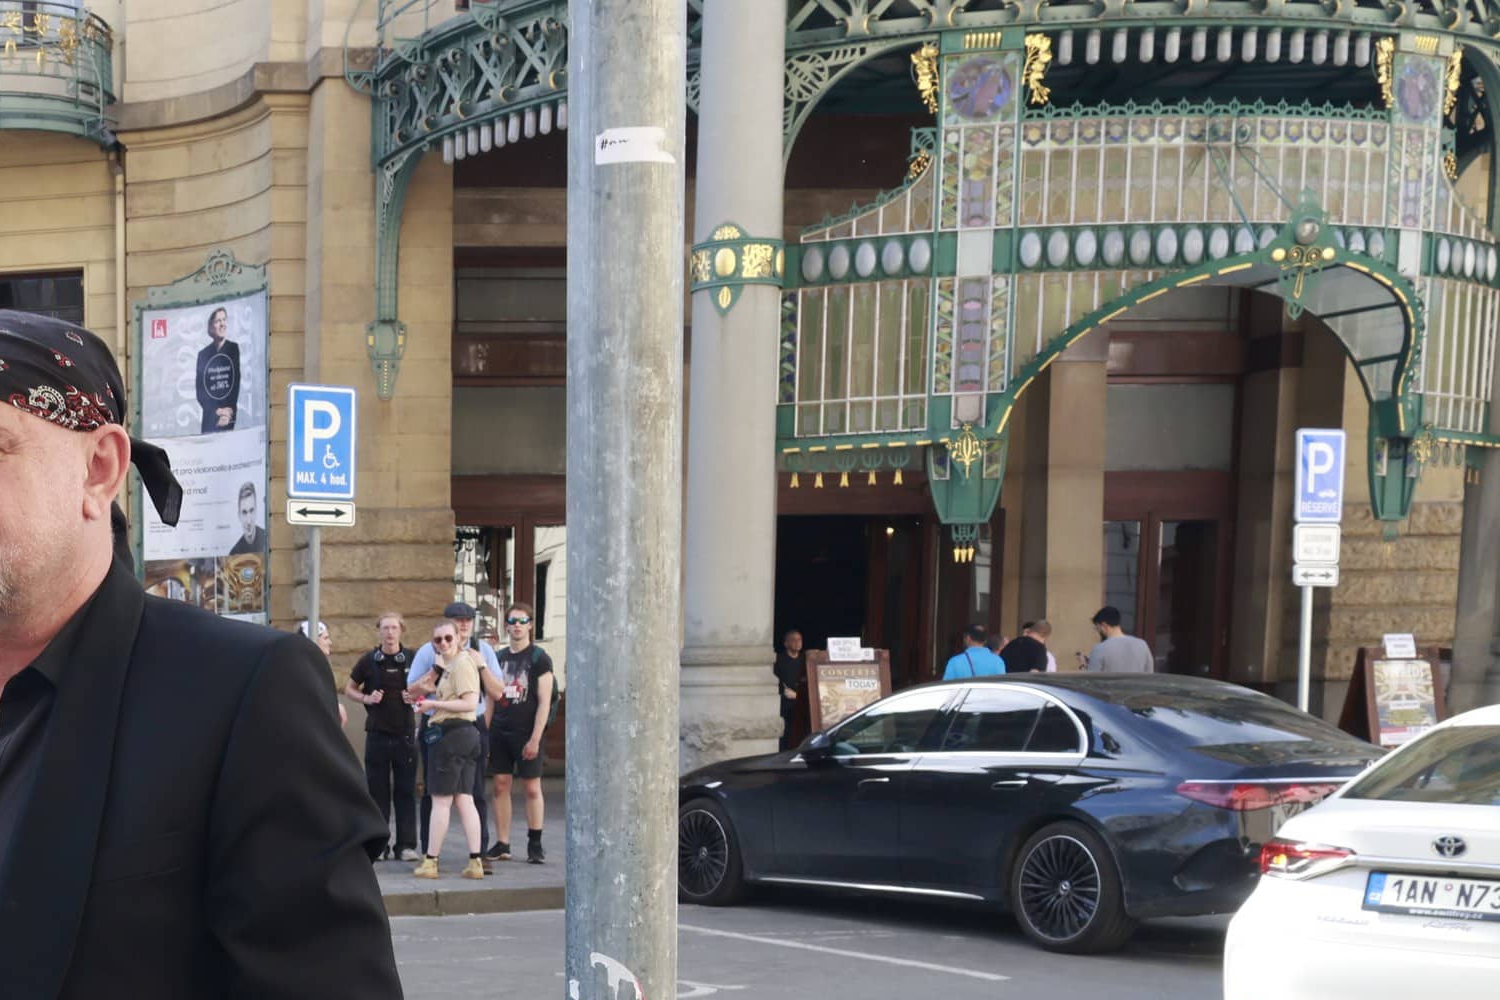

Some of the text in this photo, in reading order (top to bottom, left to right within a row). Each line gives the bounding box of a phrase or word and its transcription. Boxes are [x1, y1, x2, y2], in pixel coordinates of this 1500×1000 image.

[304, 400, 341, 462] P
[296, 472, 348, 486] MAX. 4 hod.
[1307, 442, 1334, 494] P
[1392, 879, 1437, 904] 1AN
